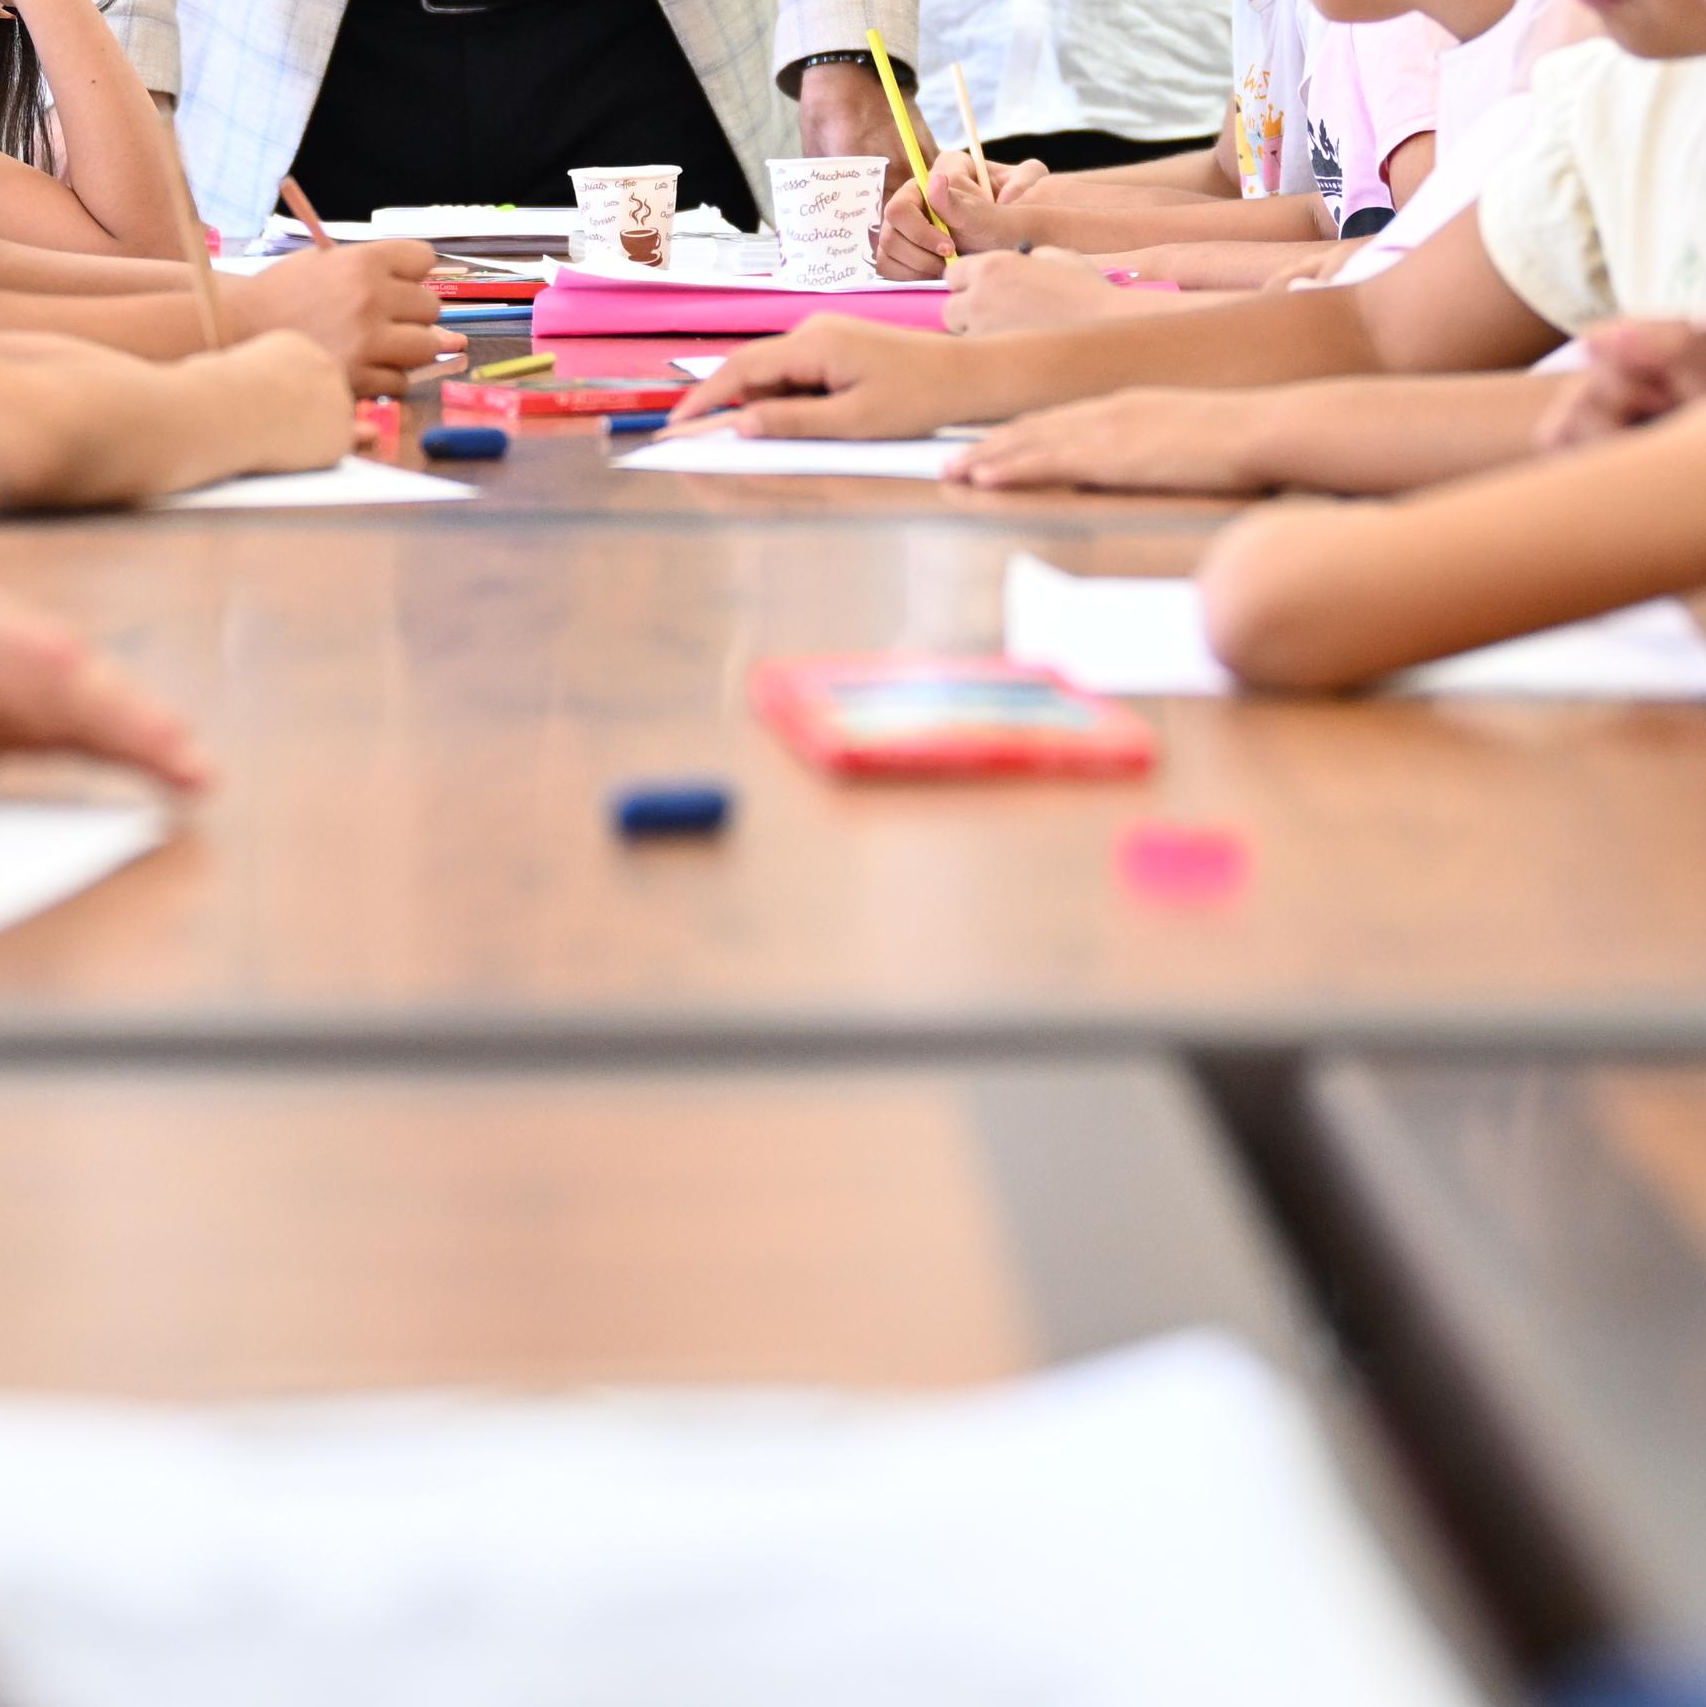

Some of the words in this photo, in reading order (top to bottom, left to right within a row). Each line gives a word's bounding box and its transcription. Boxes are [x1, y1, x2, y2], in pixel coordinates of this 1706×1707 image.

[810, 169, 861, 181] Macchiato
[799, 191, 840, 216] Coffee
[786, 225, 854, 242] Macchiato
[797, 265, 858, 286] Chocolate
[808, 262, 832, 276] Hot
